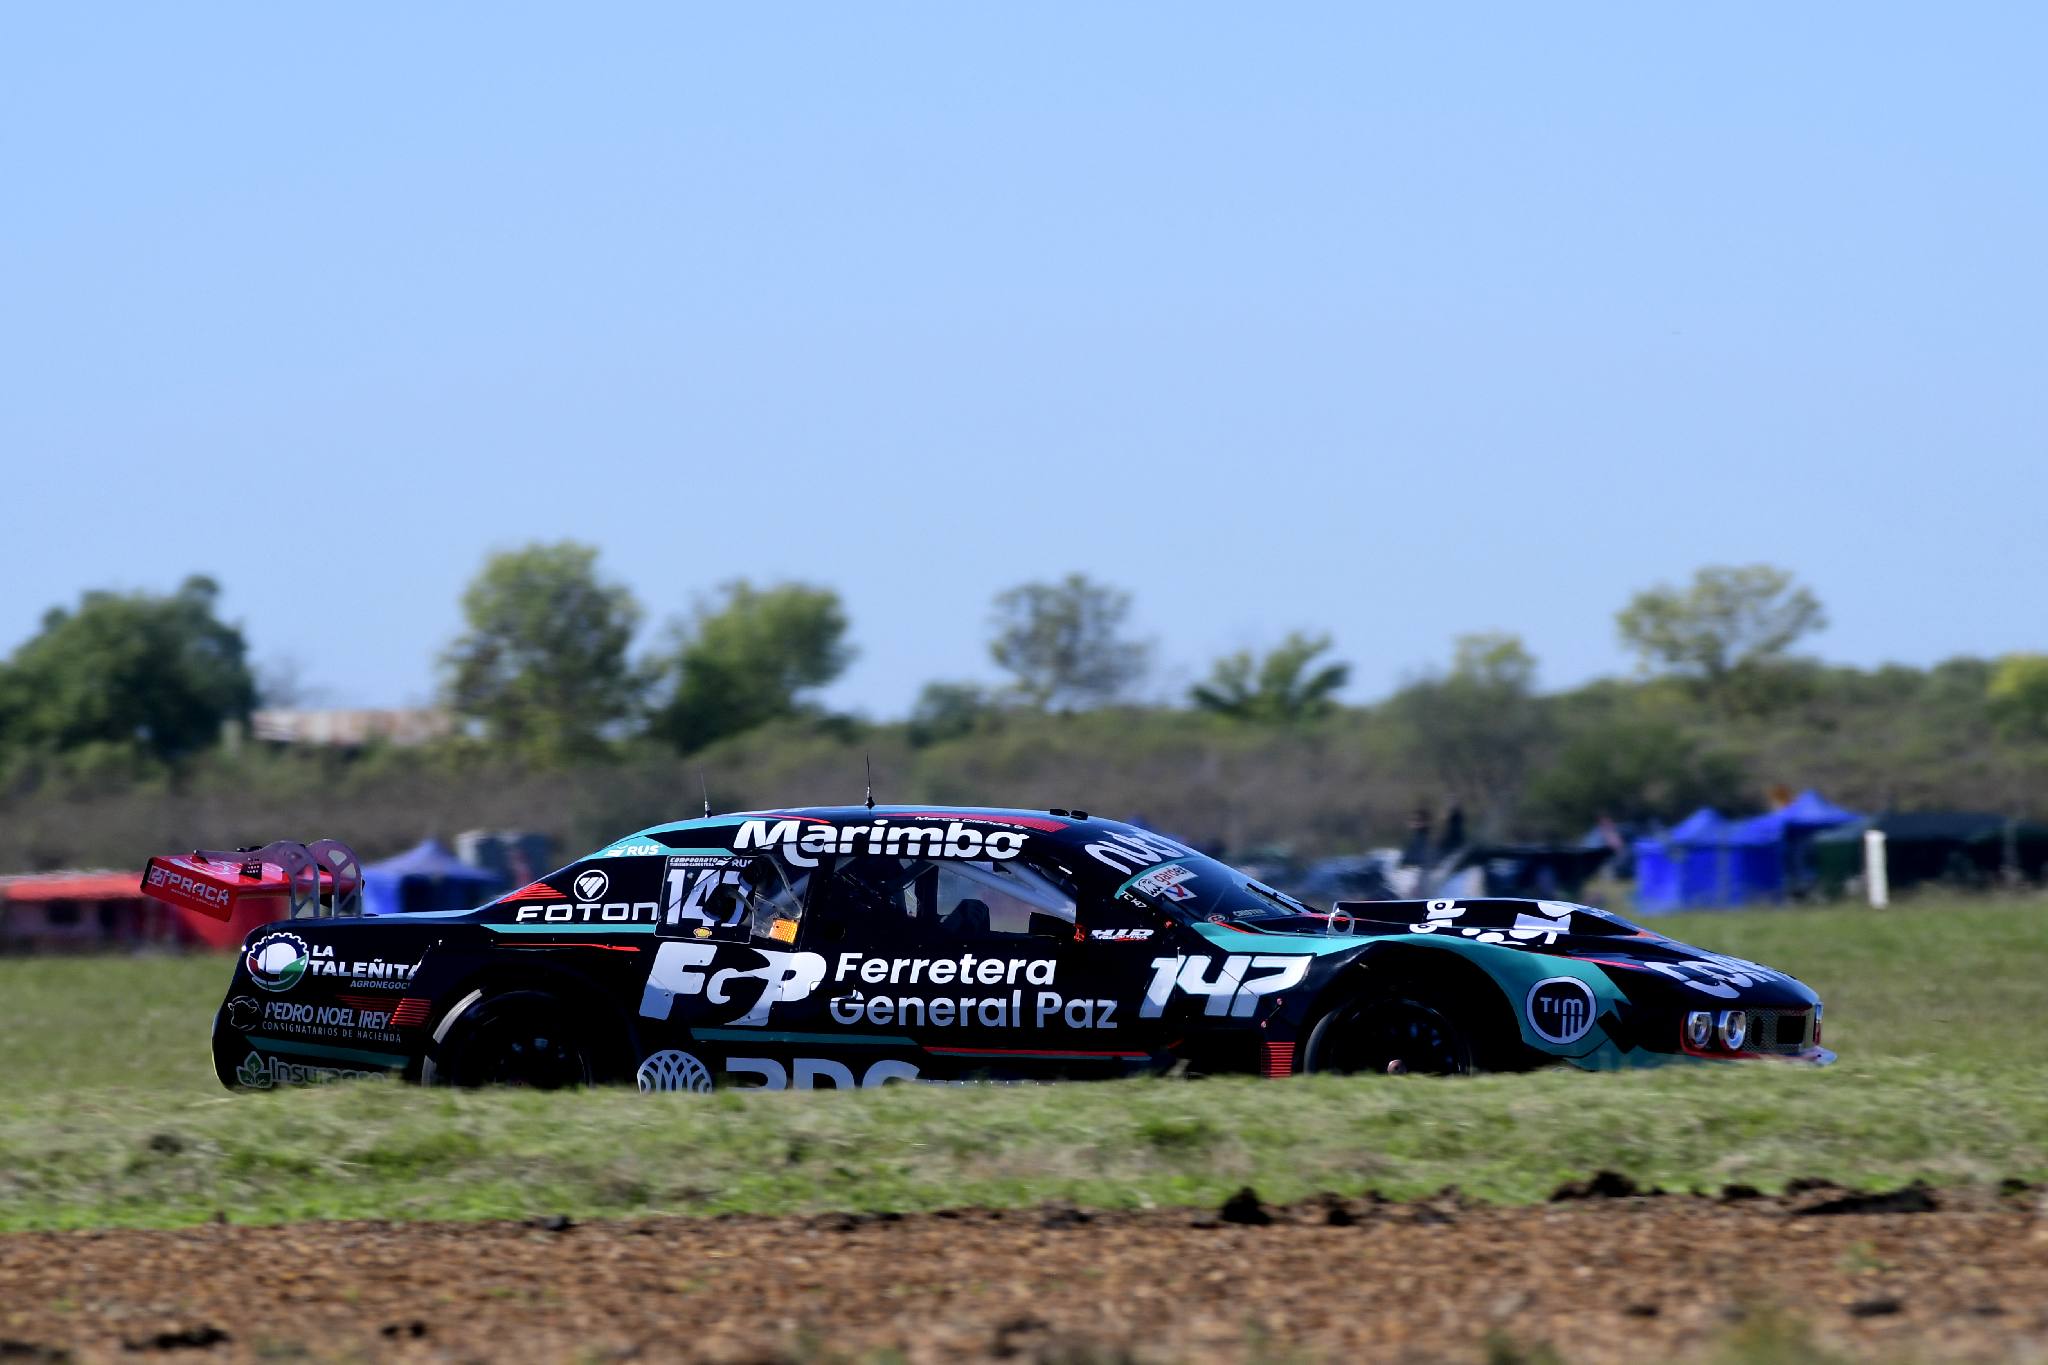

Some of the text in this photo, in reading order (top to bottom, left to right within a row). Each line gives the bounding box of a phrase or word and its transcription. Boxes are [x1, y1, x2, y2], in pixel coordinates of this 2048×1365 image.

[625, 844, 661, 856] RUS
[733, 819, 1030, 867] Marimbo
[515, 902, 659, 922] FOTON
[312, 944, 334, 957] LA
[835, 953, 1057, 986] Ferretera
[1138, 955, 1313, 1019] 147
[264, 1001, 314, 1023] PEDRO
[315, 1006, 356, 1027] NOEL
[357, 1010, 392, 1030] IREY
[829, 990, 1118, 1029] General Paz
[262, 1021, 401, 1044] CONSIGNATARIOS DE HACIENDA
